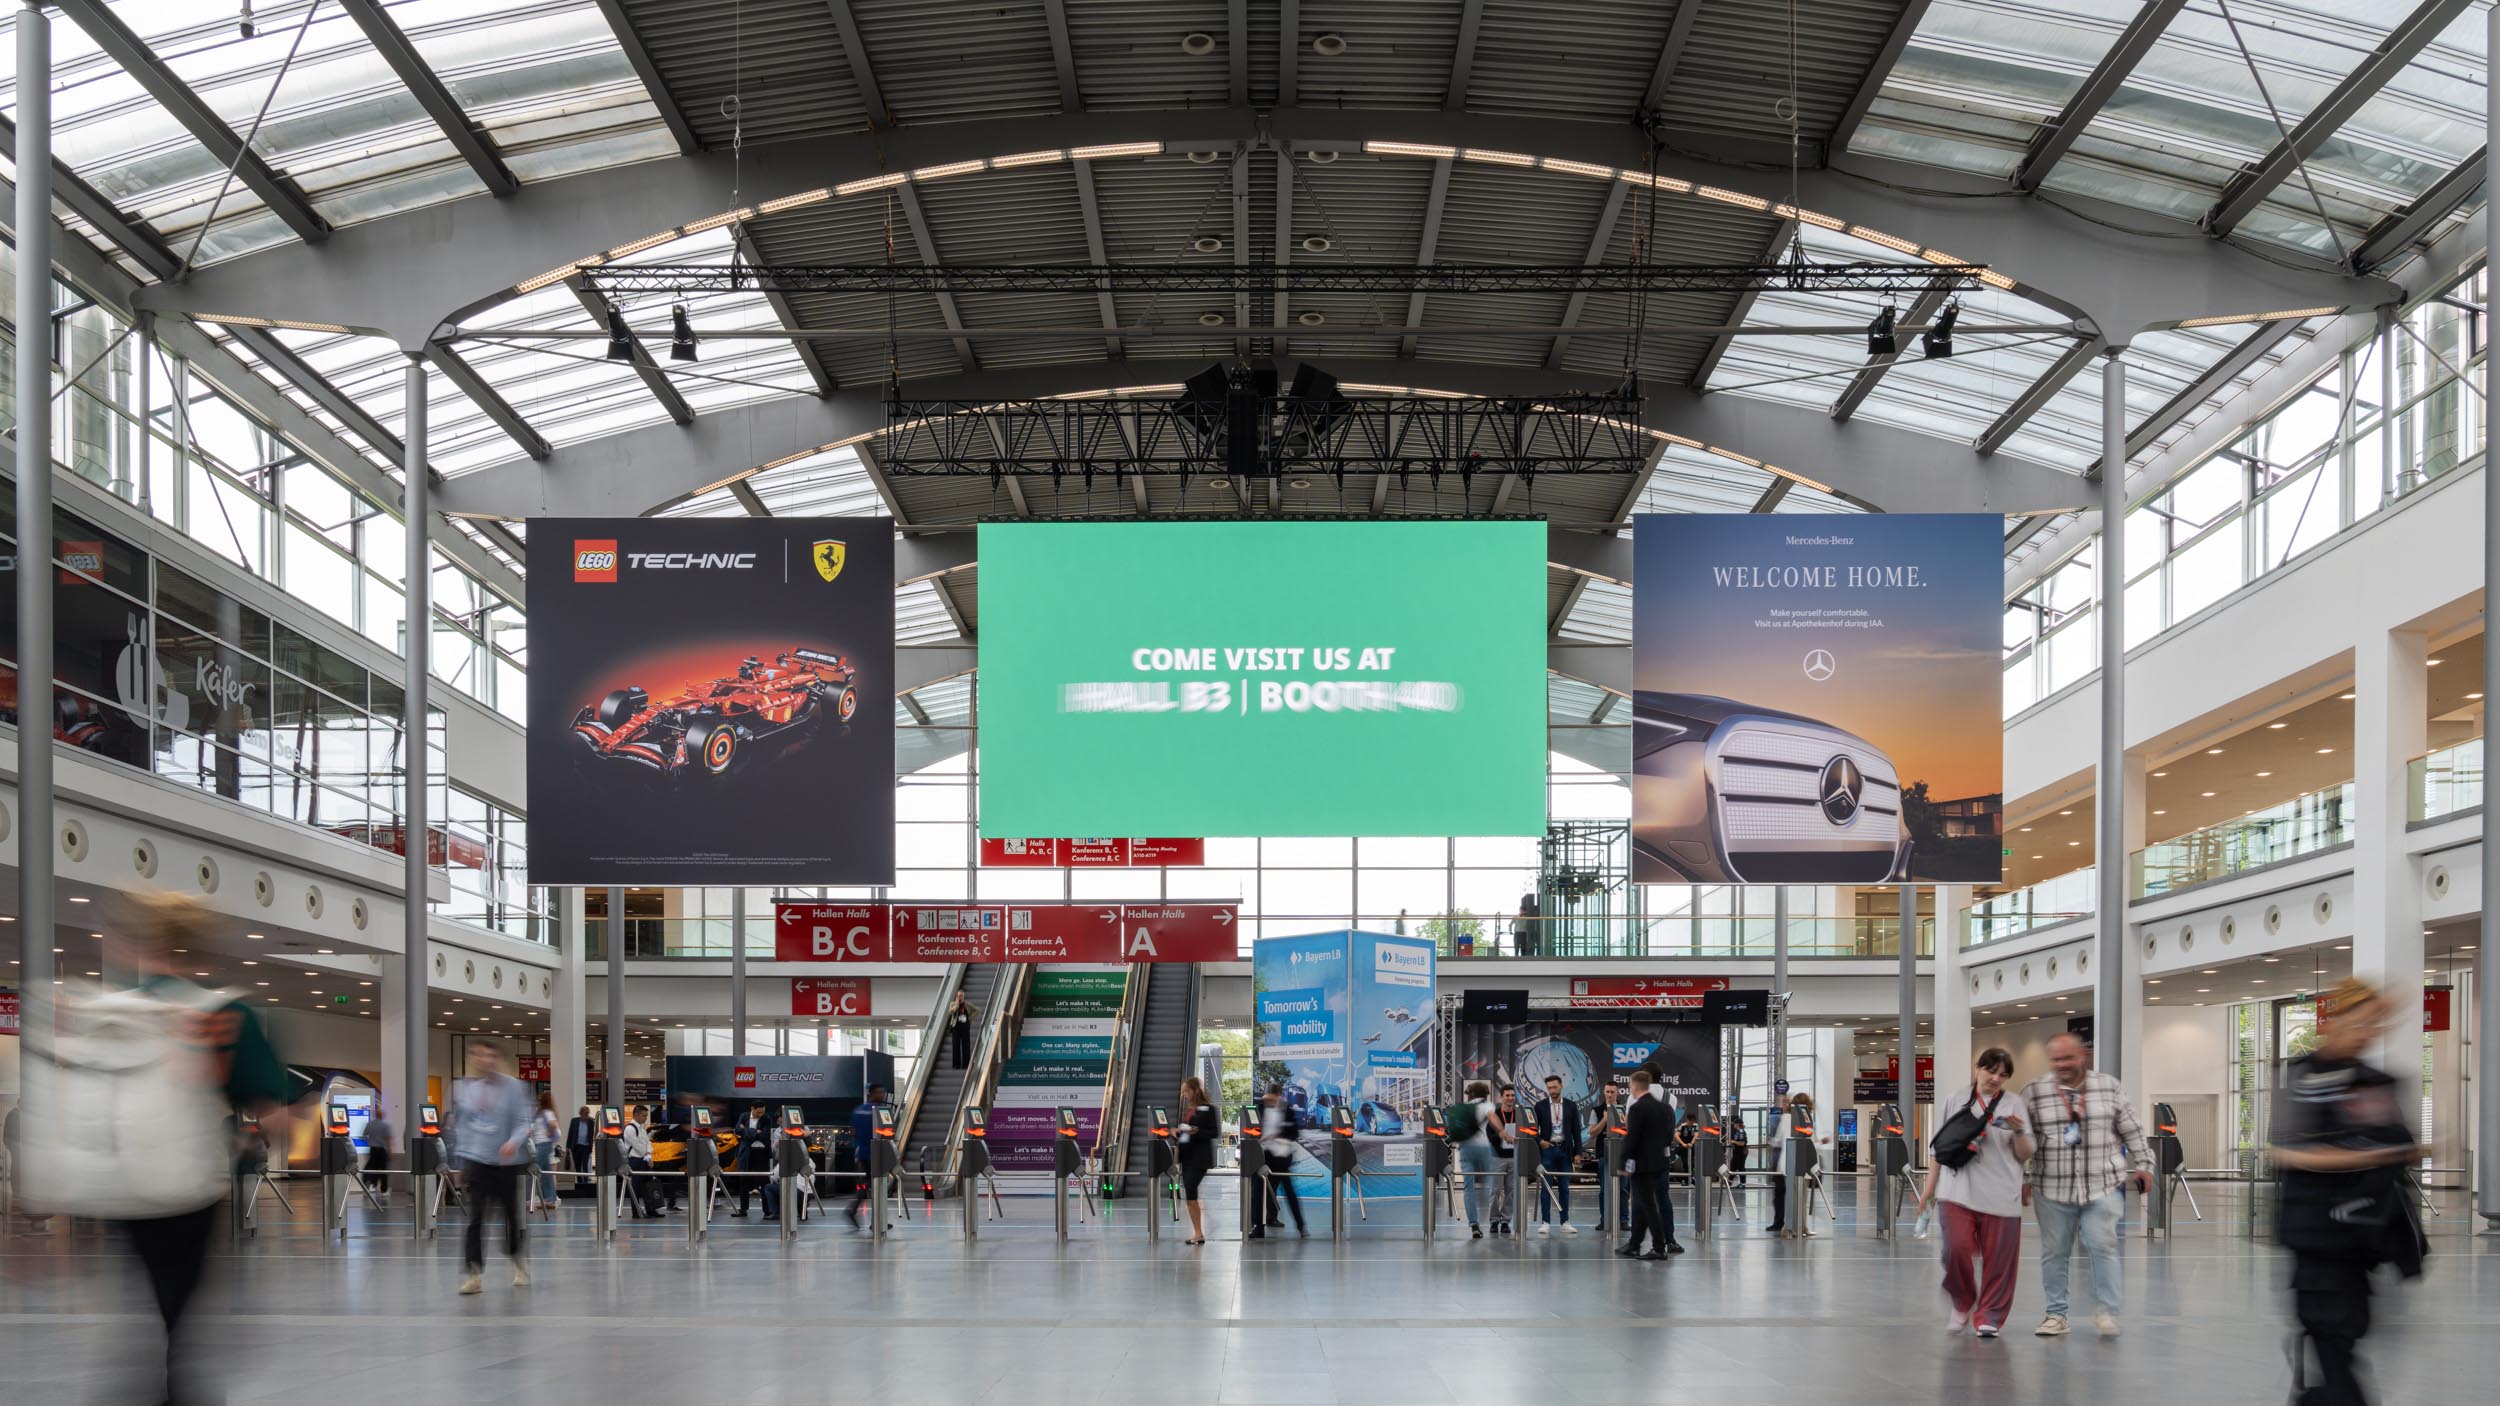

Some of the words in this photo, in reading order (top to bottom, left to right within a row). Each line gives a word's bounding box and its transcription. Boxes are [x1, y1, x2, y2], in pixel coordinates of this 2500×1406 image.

[1785, 535, 1854, 545] Mercedes-Benz
[577, 551, 615, 569] LEGO
[627, 553, 756, 569] TECHNIC
[1712, 566, 1837, 588] WELCOME
[1847, 566, 1928, 588] HOME.
[1770, 609, 1790, 617] Make
[1791, 609, 1822, 618] yourself
[1822, 609, 1869, 617] comfortable.
[1755, 619, 1771, 627] Visit
[1791, 619, 1844, 629] Apothekenhof
[1844, 620, 1869, 629] during
[1132, 647, 1217, 671] COME
[1224, 647, 1304, 671] VISIT
[1313, 647, 1351, 671] US
[1357, 647, 1396, 671] AT
[196, 655, 256, 711] Käfer
[1179, 681, 1232, 713] B3
[275, 733, 302, 764] See
[1029, 839, 1046, 847] Halls
[1029, 848, 1037, 856] A,
[1038, 848, 1045, 856] B,
[1071, 846, 1104, 854] Konferenz
[1107, 855, 1113, 863] B,
[812, 908, 844, 919] Hallen
[846, 908, 871, 919] Halls
[1127, 909, 1159, 919] Hallen
[1161, 909, 1185, 919] Halls
[812, 926, 870, 961] B,C
[917, 933, 966, 944] Konferenz
[968, 934, 979, 945] B,
[981, 934, 989, 943] C
[1011, 936, 1053, 945] Konferenz
[1055, 936, 1064, 945] A
[1128, 927, 1158, 957] A
[917, 946, 970, 956] Conference
[971, 946, 982, 957] B,
[983, 946, 991, 956] C
[1011, 947, 1057, 957] Conference
[1058, 948, 1067, 957] A
[816, 981, 839, 989] Hallen
[840, 981, 857, 989] Halls
[1653, 980, 1675, 988] Hallen
[1676, 980, 1694, 988] Halls
[816, 993, 857, 1015] B,C
[1263, 996, 1318, 1014] Tomorrow's
[1287, 1019, 1328, 1037] mobility
[1613, 1047, 1649, 1064] SAP
[736, 1073, 754, 1082] LEGO
[760, 1073, 824, 1081] TECHNIC
[1031, 1154, 1054, 1162] mobility
